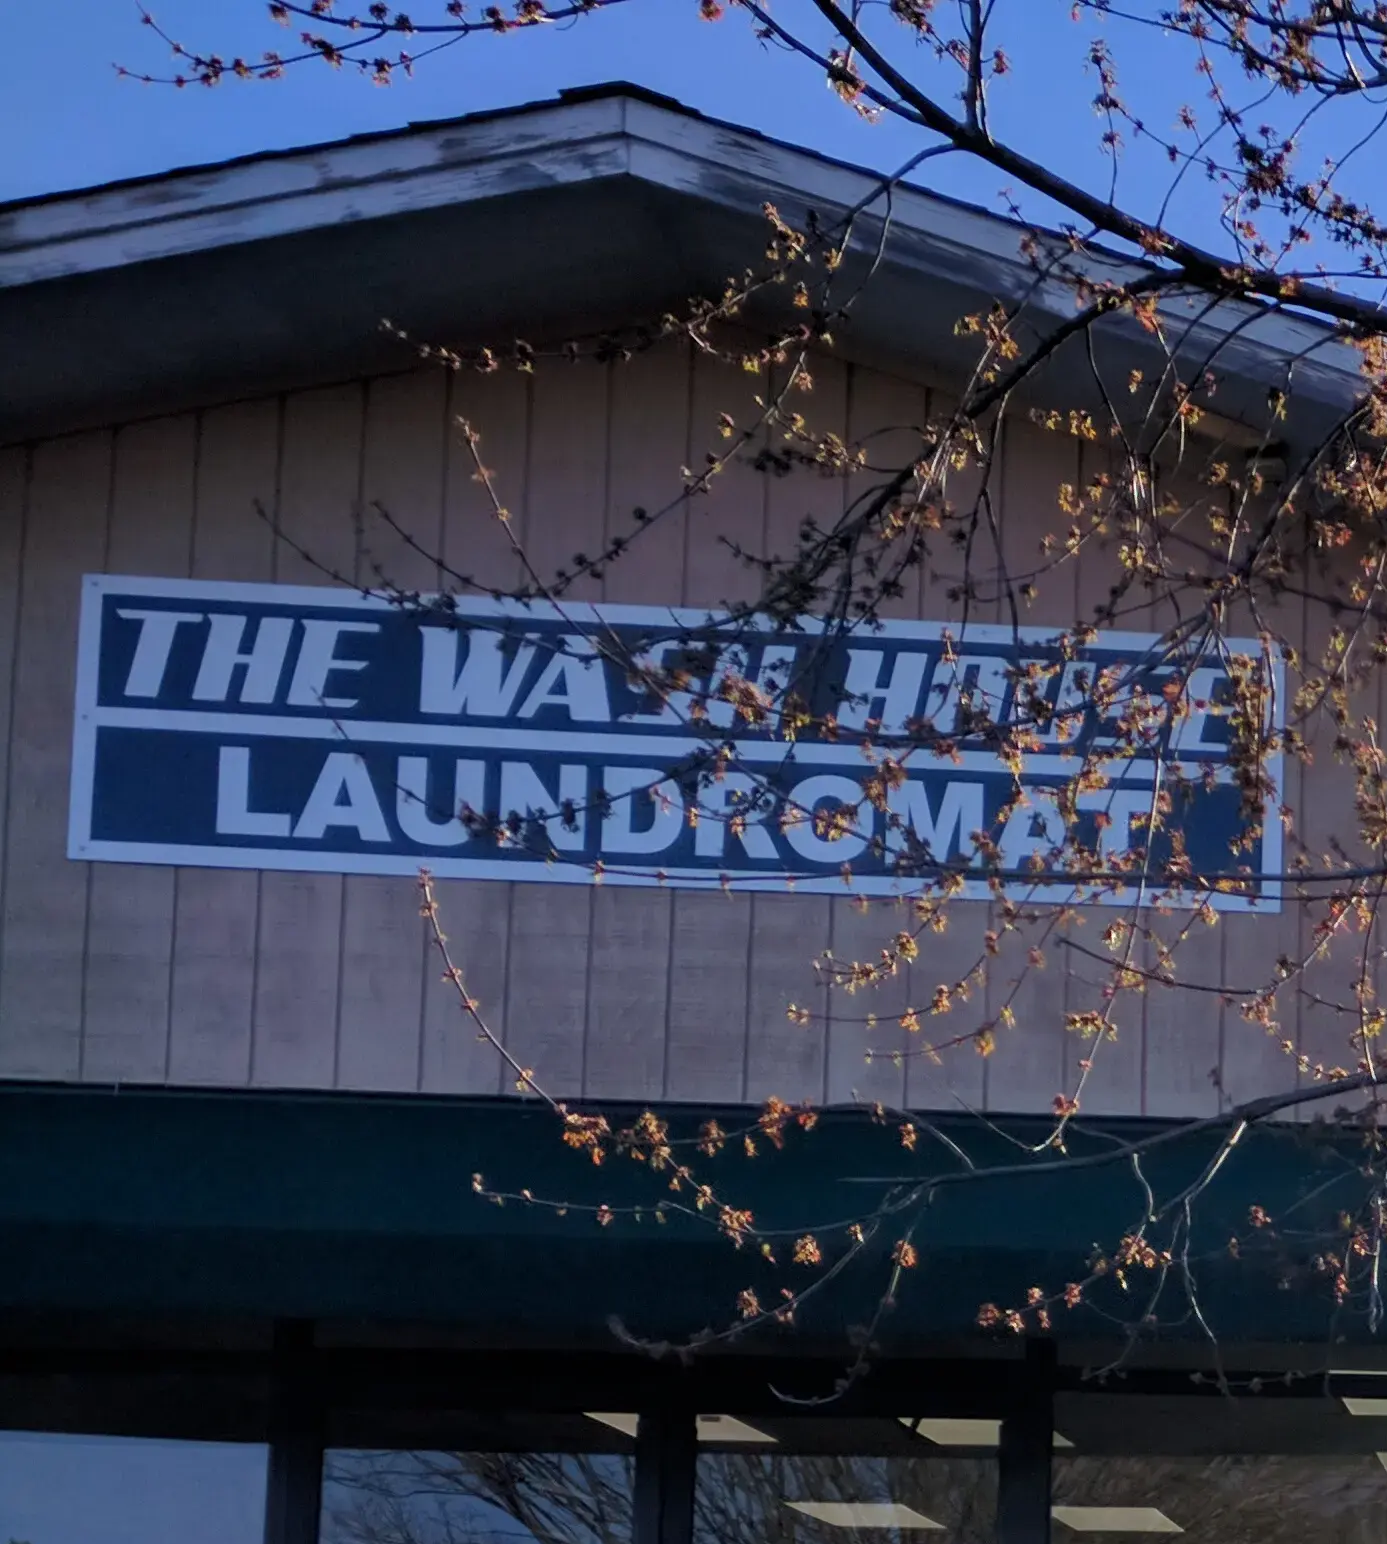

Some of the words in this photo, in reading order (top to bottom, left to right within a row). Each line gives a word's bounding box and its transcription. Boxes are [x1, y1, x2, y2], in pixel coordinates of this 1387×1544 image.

[115, 607, 381, 708] THE
[418, 624, 797, 733] WASH
[215, 746, 1155, 873] LAUNDROMAT
